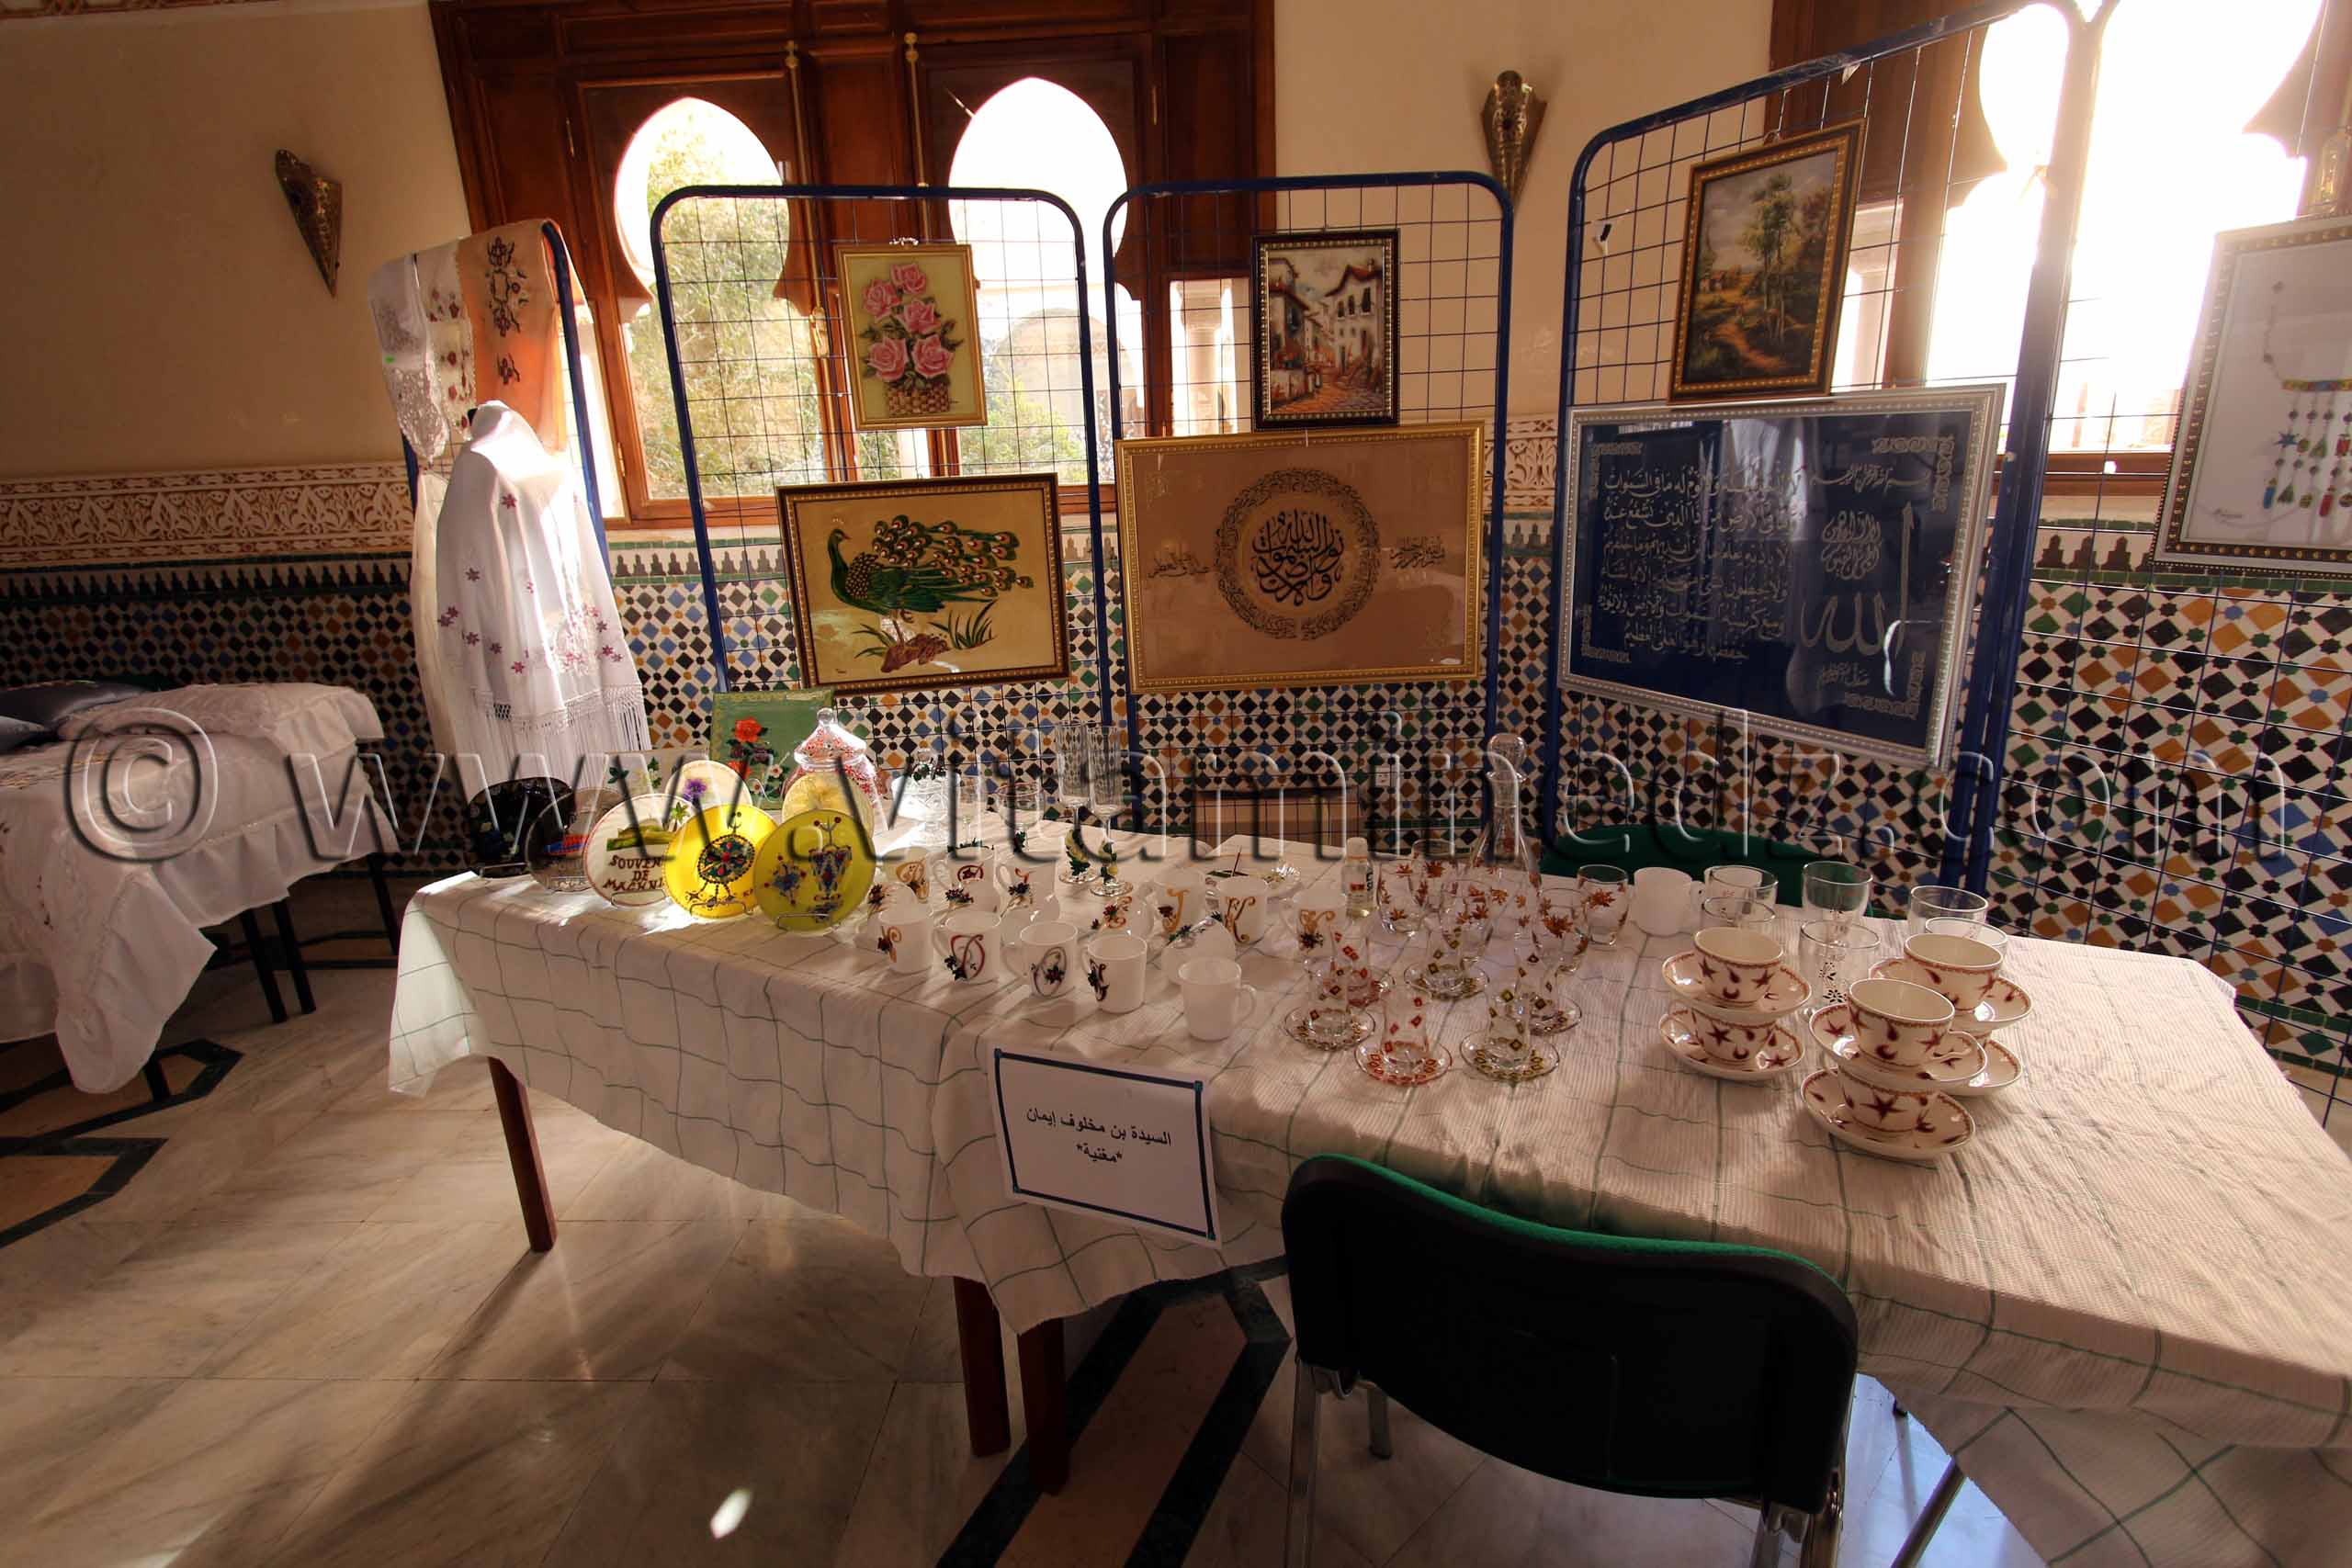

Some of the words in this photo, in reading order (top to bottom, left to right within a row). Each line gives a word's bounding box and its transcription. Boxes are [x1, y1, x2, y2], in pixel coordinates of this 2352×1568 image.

[609, 854, 663, 869] SOUVEN
[632, 870, 650, 883] DE
[1026, 1107, 1057, 1128] إيمان
[1059, 1112, 1105, 1133] مخلوف
[1110, 1122, 1127, 1142] بن
[1131, 1126, 1172, 1147] السيدة
